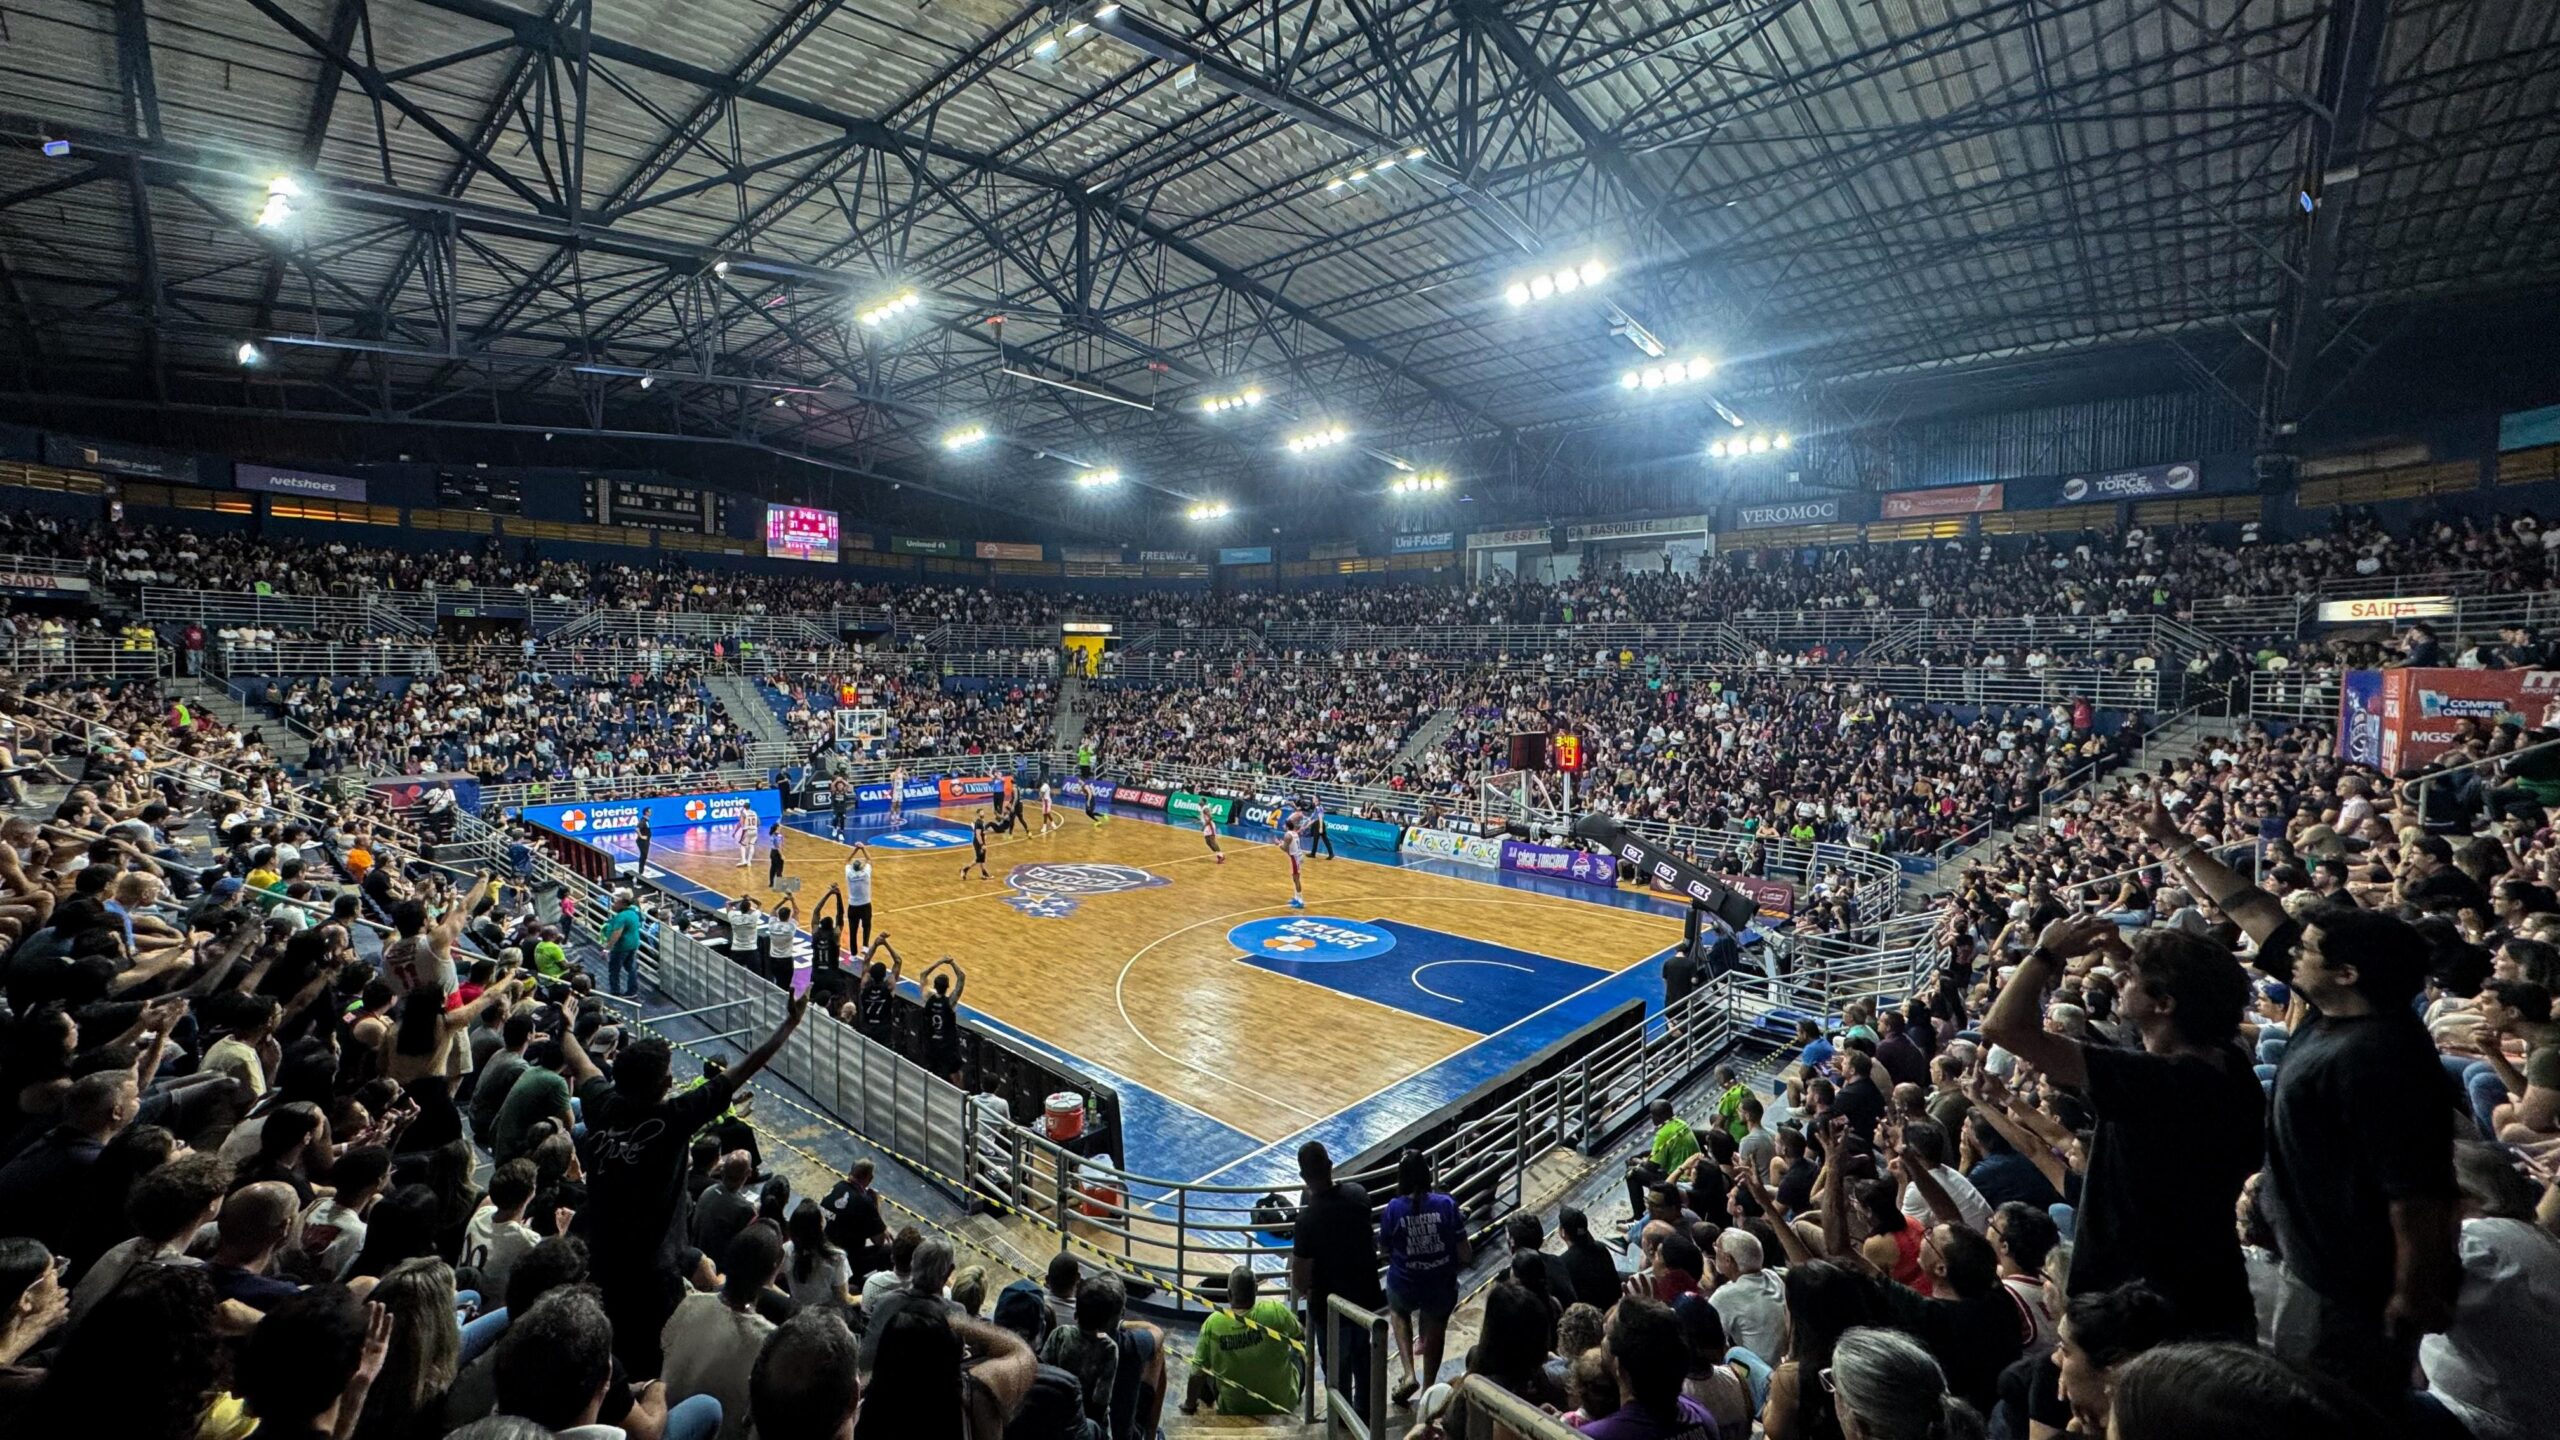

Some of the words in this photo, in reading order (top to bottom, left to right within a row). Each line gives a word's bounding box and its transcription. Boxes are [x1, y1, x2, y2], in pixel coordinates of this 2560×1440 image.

[2096, 476, 2148, 491] TORCE
[1741, 503, 1835, 524] VEROMOC
[1503, 529, 1533, 542] SESI
[1538, 526, 1584, 540] FRCA
[1589, 521, 1653, 537] BASQUETE
[906, 540, 937, 549] Unimed
[1140, 551, 1189, 561] FREEWAY
[2449, 700, 2505, 709] COMPRE
[2442, 708, 2492, 717] ONLINE
[1560, 747, 1575, 766] 19
[860, 789, 891, 801] CAIX
[1117, 787, 1139, 801] SESI
[1142, 793, 1165, 807] SESI
[591, 805, 638, 818] loterias
[592, 815, 639, 830] CAIXA
[1276, 924, 1363, 949] loterias
[818, 949, 830, 962] 11
[866, 1000, 884, 1015] 77
[932, 1014, 942, 1030] 9
